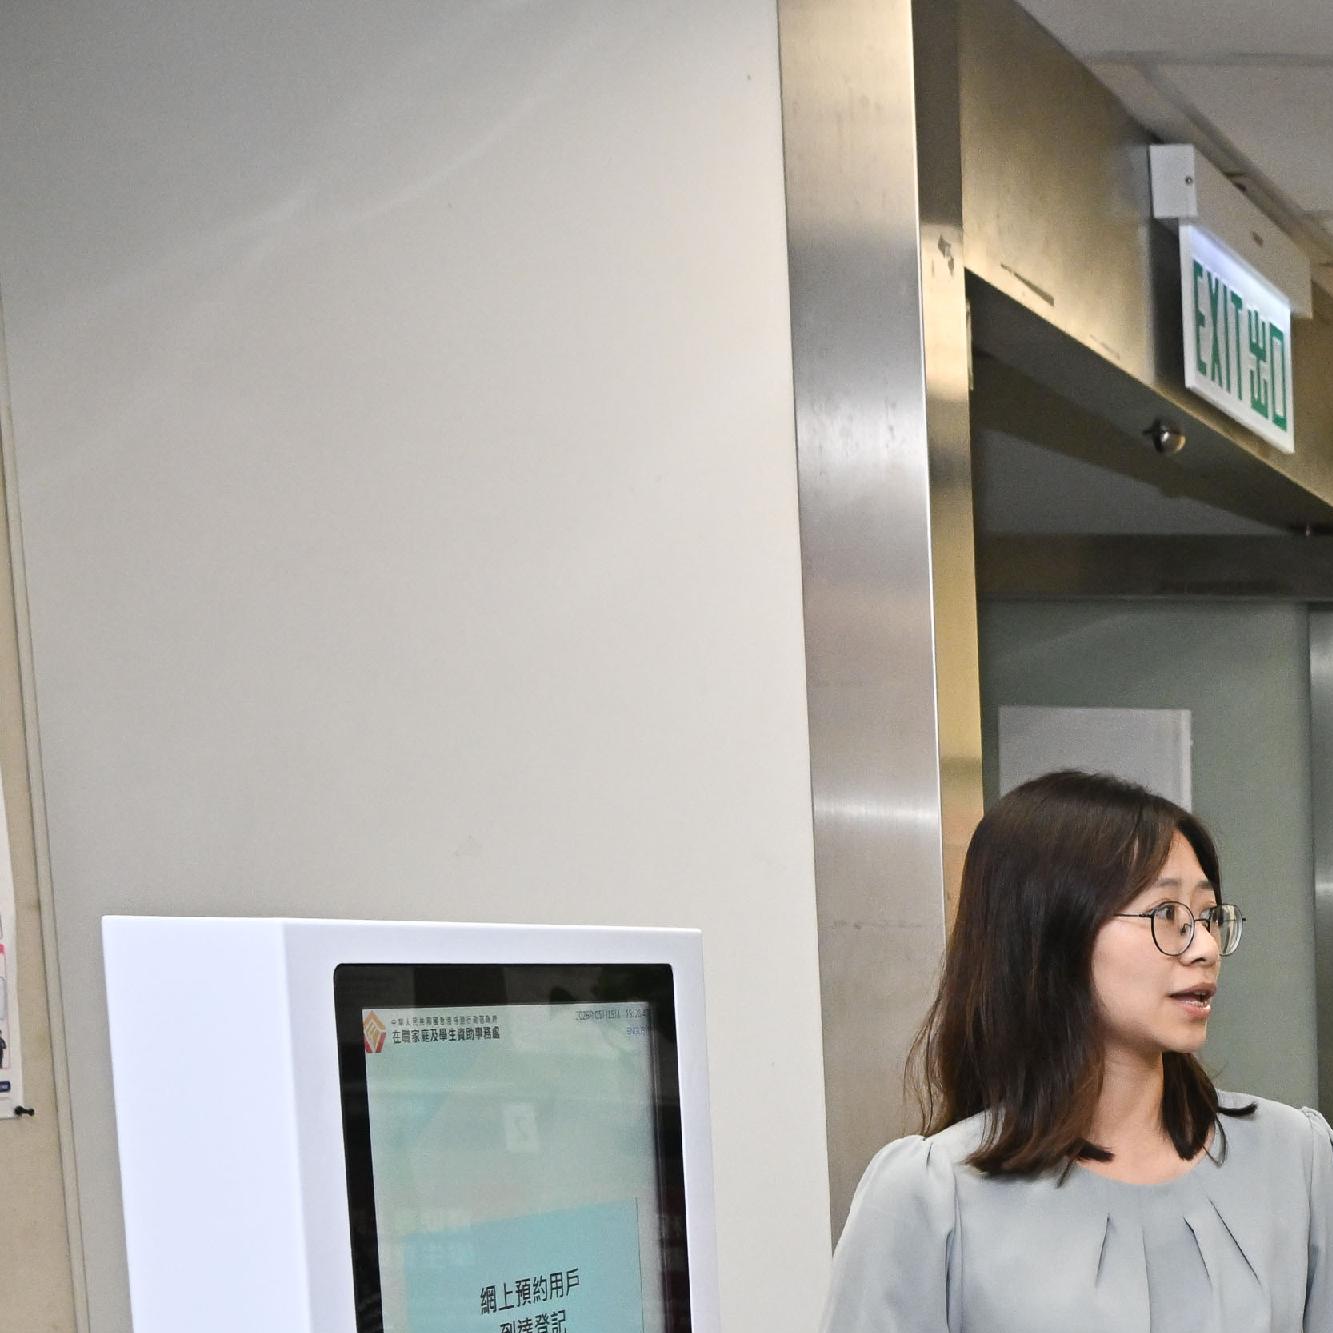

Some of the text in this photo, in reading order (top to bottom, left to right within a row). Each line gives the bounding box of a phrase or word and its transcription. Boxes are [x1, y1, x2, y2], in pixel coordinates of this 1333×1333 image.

[1193, 259, 1287, 432] EXIT 出口
[480, 1267, 580, 1315] 網上預約用戶
